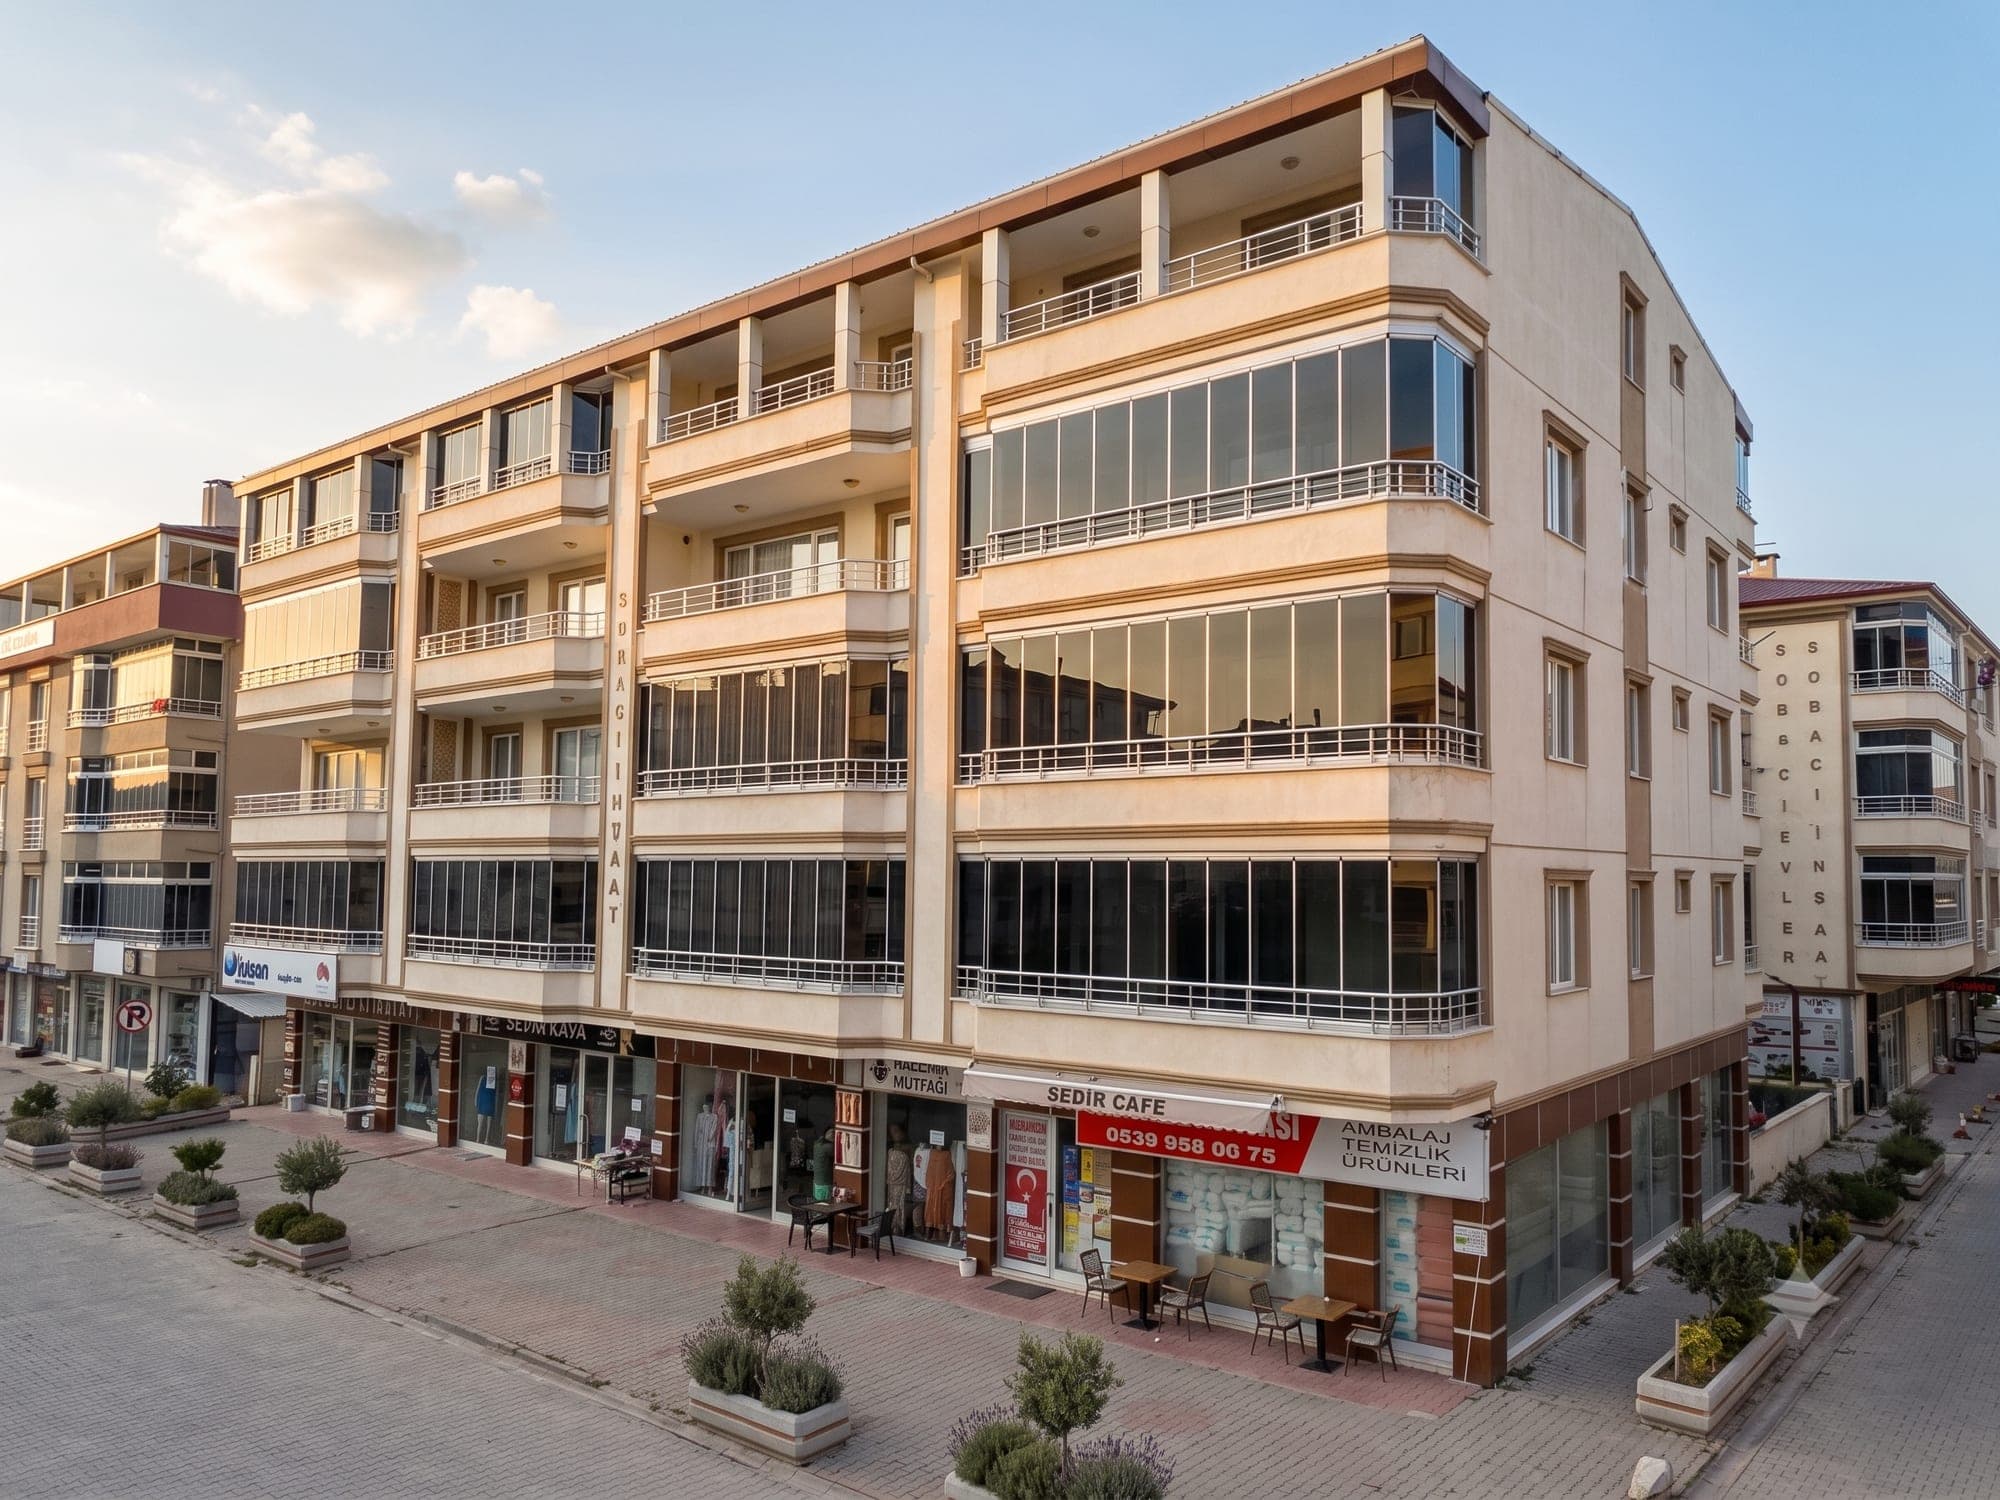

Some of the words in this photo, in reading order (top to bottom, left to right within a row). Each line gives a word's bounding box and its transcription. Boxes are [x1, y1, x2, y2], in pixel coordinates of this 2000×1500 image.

[1047, 1087, 1106, 1108] SEDİR
[1112, 1094, 1166, 1115] CAFE
[1106, 1127, 1158, 1147] 0539
[1165, 1134, 1205, 1154] 958
[1211, 1141, 1240, 1160] 06
[1247, 1145, 1276, 1164] 75
[1341, 1121, 1450, 1144] AMBALAJ
[1341, 1137, 1451, 1162] TEMİZLİK
[1342, 1152, 1466, 1182] ÜRÜNLERİ
